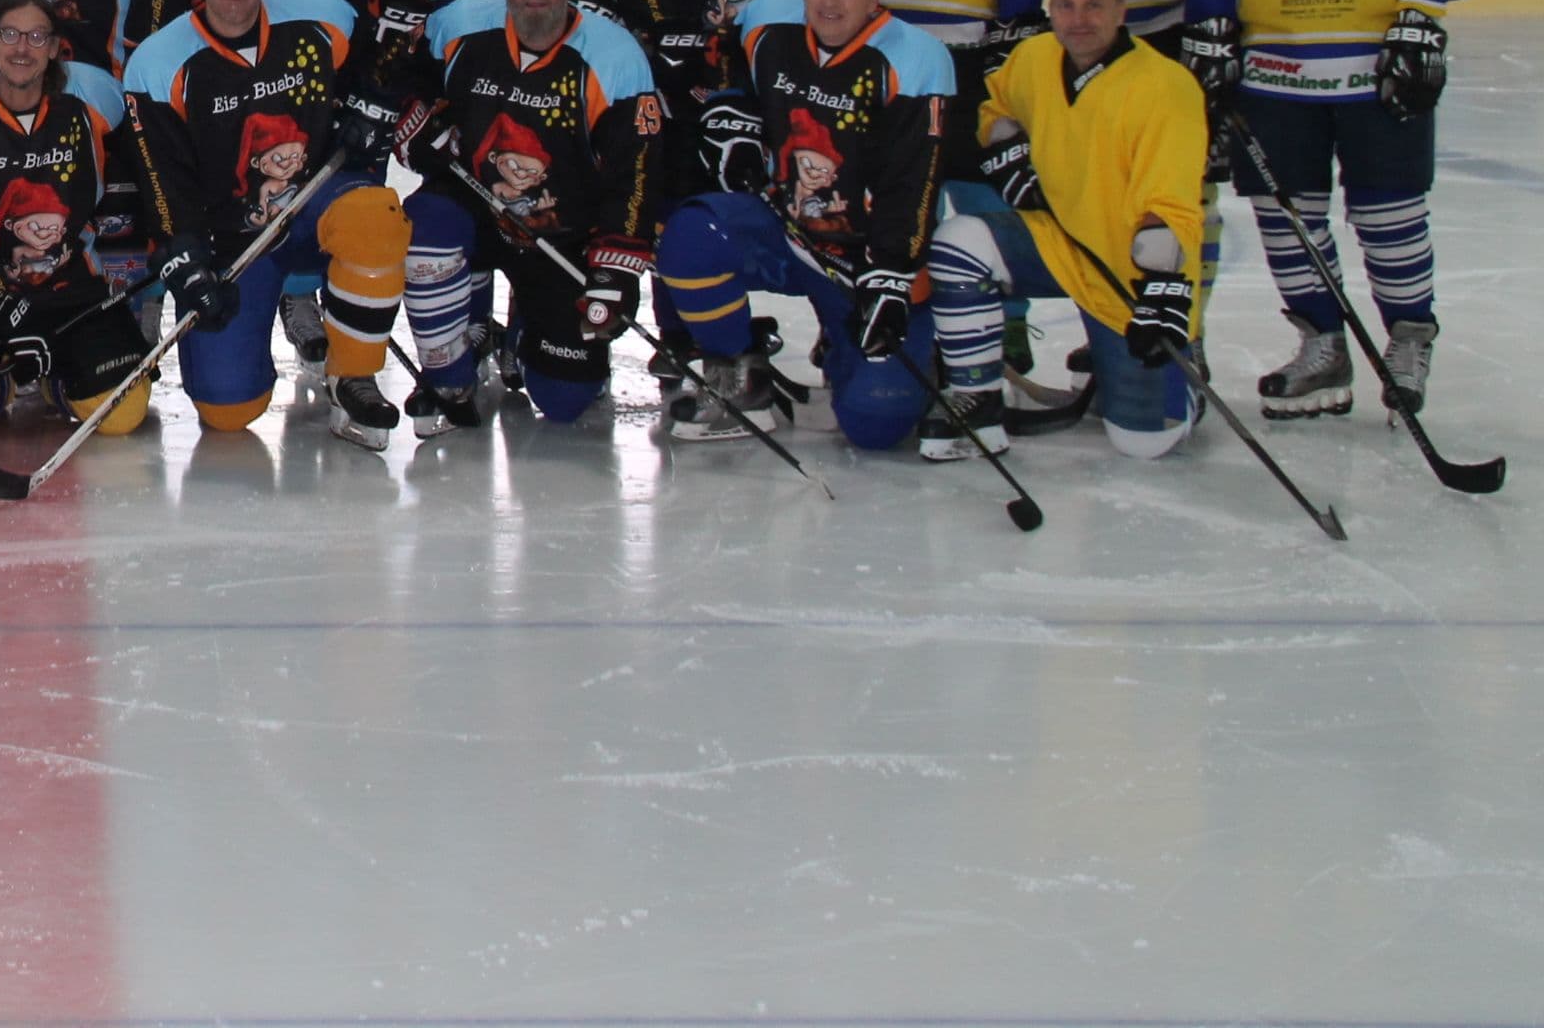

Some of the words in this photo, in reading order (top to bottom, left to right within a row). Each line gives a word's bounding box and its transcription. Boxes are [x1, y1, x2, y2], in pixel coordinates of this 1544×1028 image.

[212, 95, 239, 114] Eis
[253, 71, 305, 100] Buaba
[470, 78, 499, 96] Eis
[508, 86, 561, 109] Buaba
[1244, 67, 1340, 90] Container
[345, 94, 400, 124] EASTO
[633, 95, 662, 135] 49
[539, 339, 589, 361] Reebok
